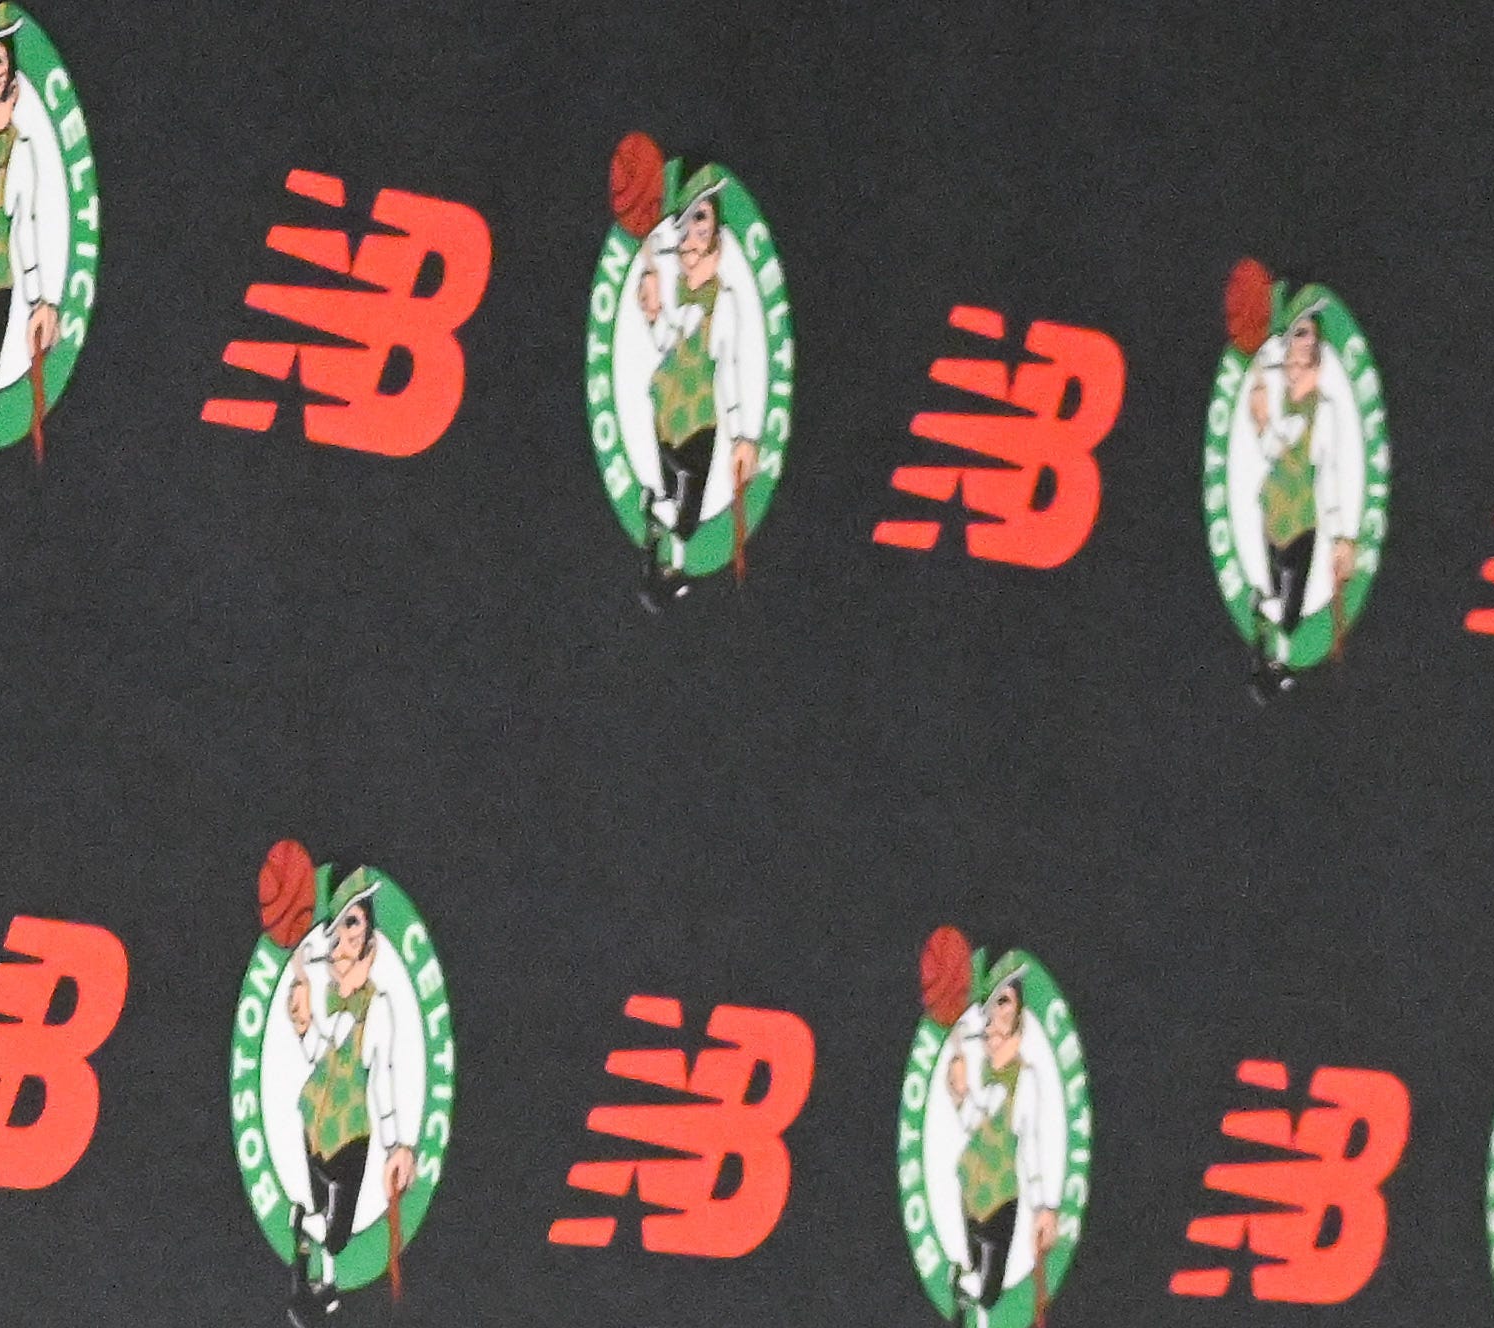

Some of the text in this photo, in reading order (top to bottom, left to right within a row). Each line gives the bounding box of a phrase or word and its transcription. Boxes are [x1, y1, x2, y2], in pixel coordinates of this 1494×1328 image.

[44, 69, 98, 346] CELTICS
[588, 221, 793, 498] BOSTON CELTICS
[232, 921, 454, 1221] BOSTON CELTICS
